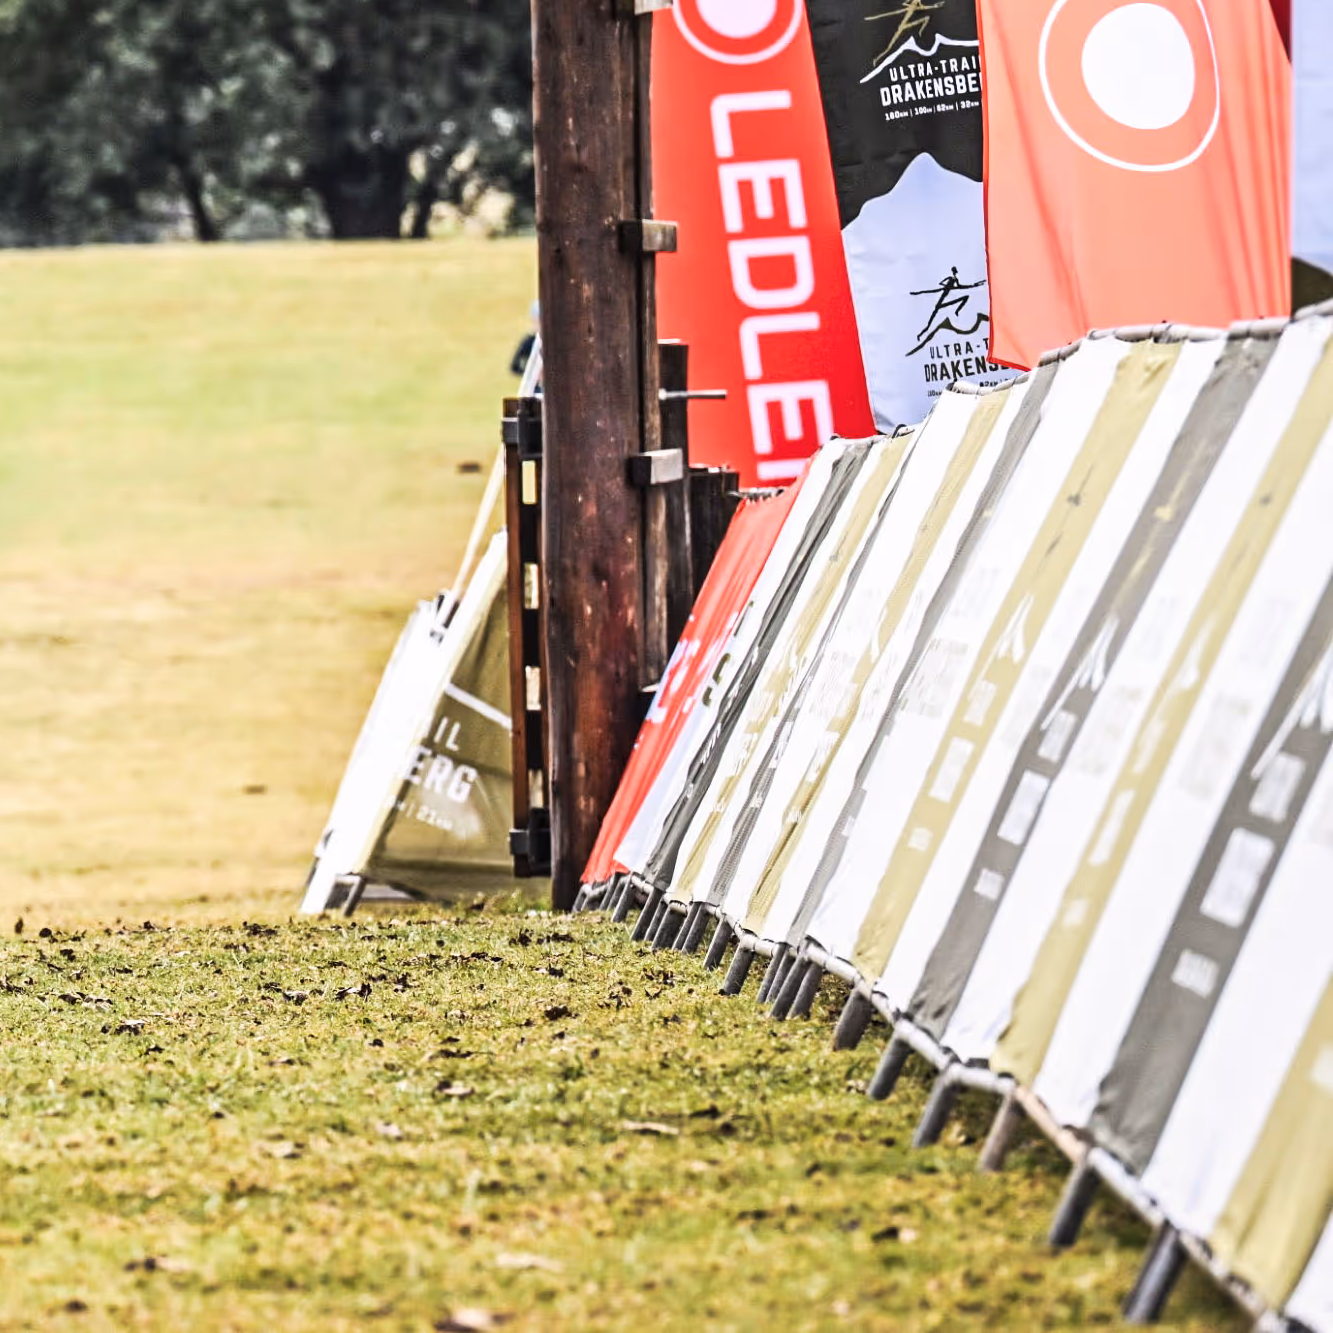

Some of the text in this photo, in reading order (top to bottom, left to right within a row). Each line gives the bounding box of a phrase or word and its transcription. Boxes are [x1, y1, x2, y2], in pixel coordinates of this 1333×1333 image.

[880, 71, 983, 107] DRAKENSBE
[710, 90, 834, 481] LEDLE
[923, 356, 1011, 383] DRAKEN
